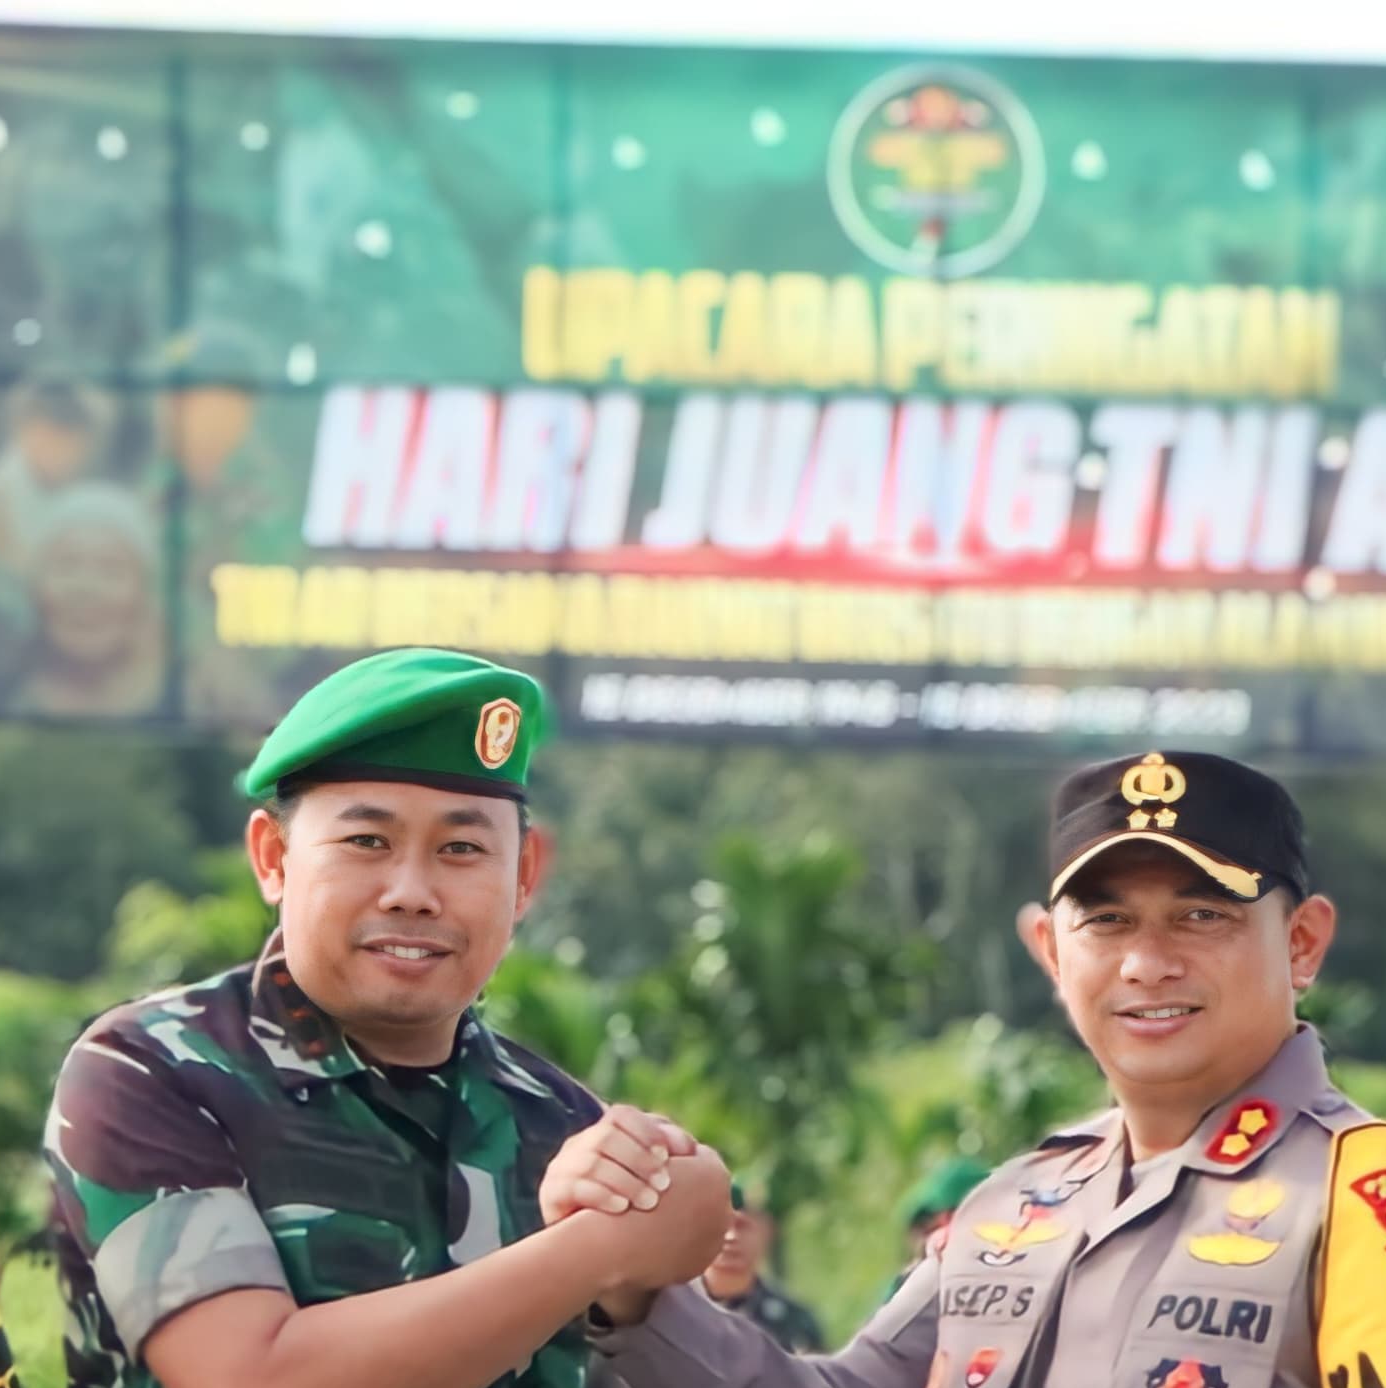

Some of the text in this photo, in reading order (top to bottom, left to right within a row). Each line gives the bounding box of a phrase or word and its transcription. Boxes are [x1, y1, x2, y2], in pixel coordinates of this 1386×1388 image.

[522, 265, 877, 386] UPACARA
[303, 386, 638, 551] HARI
[641, 392, 1082, 560] JUANG
[1090, 402, 1319, 569] TNI
[1147, 1294, 1273, 1343] POLRI
